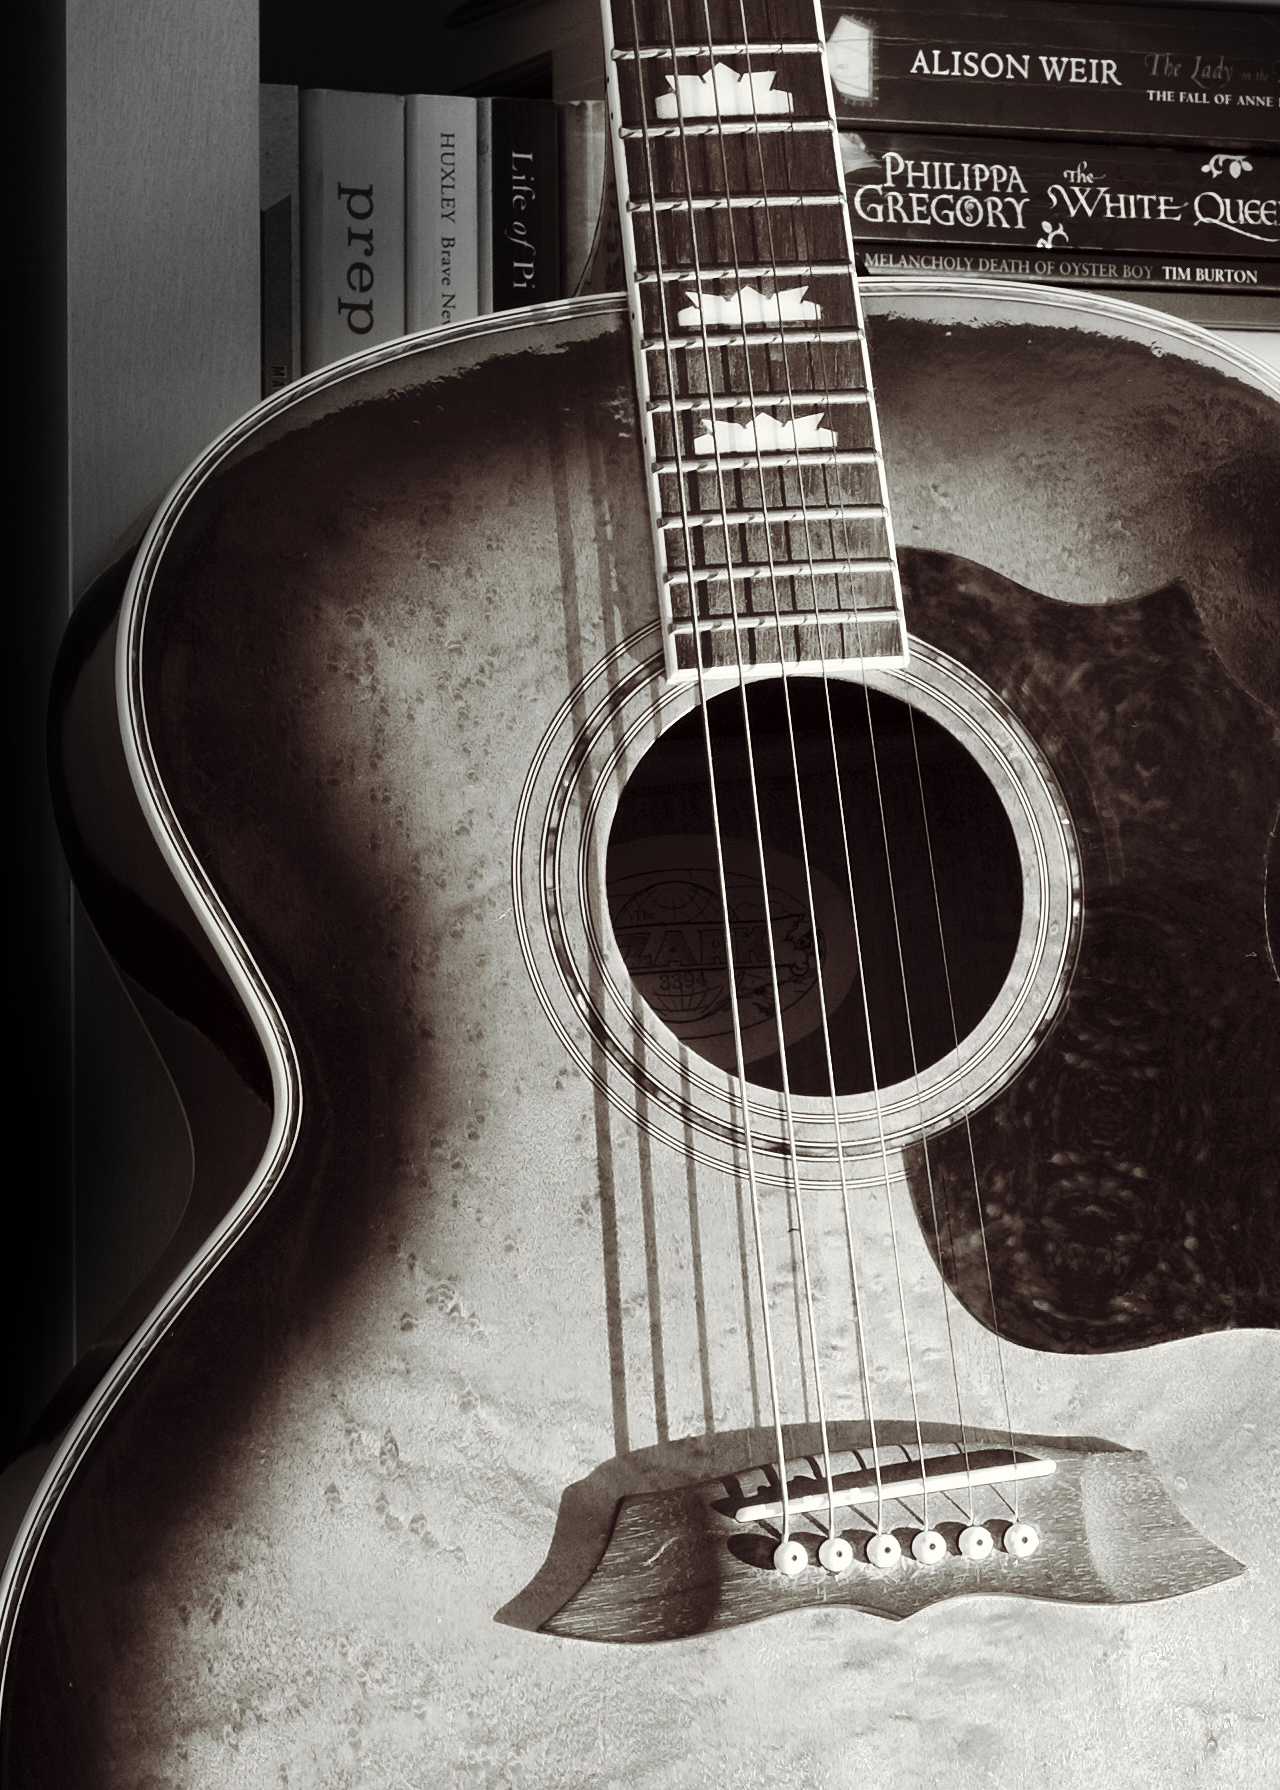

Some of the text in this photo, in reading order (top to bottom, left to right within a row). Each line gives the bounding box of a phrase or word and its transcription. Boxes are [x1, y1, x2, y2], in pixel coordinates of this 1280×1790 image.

[910, 49, 1122, 86] ALISON WEIR
[1144, 52, 1181, 77] The
[1190, 55, 1233, 90] Lady
[1147, 89, 1175, 102] THE
[1179, 91, 1210, 104] FALL
[1214, 93, 1232, 105] OF
[1237, 95, 1274, 107] ANNE
[882, 152, 1028, 193] PHILIPPA
[1063, 161, 1106, 184] The
[440, 132, 456, 286] HUXLEY Brave
[504, 151, 537, 289] Life of Pi
[854, 184, 1031, 229] GREGORY
[1047, 185, 1189, 220] WHITE
[337, 182, 375, 336] prep
[864, 252, 1258, 284] MELANCHOLY DEATH OF OYSTER BOY TIM BURTON
